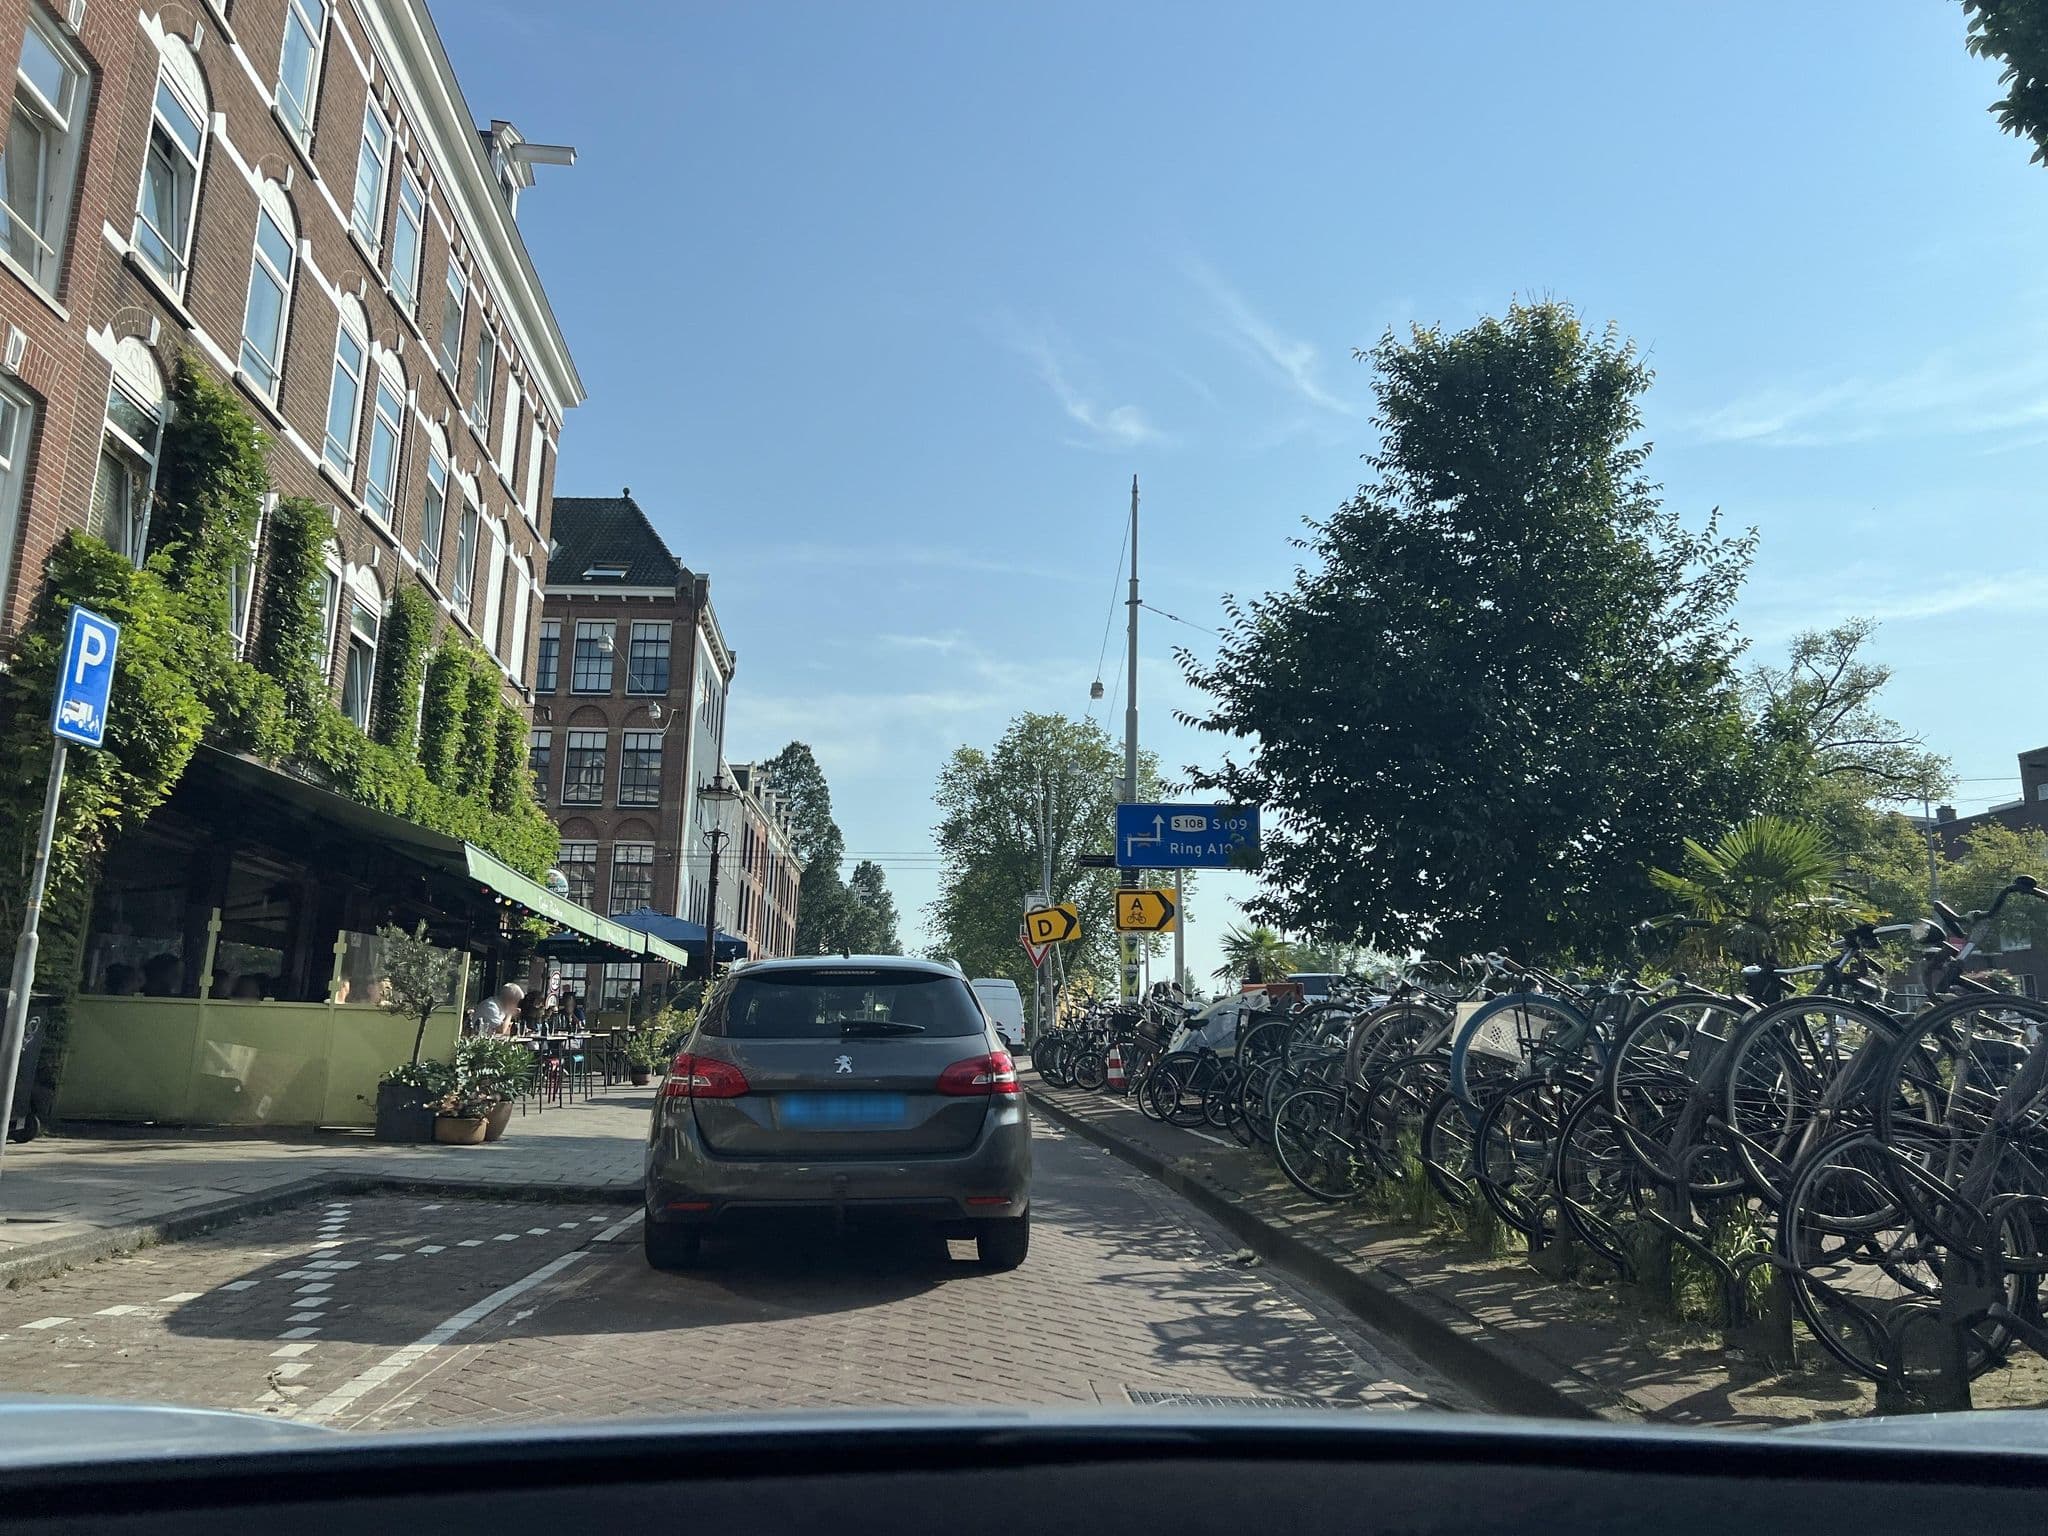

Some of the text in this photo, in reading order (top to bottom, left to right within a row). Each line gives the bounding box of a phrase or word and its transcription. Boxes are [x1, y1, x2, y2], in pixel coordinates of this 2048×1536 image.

[75, 623, 106, 684] P
[1174, 819, 1203, 828] S 108
[1212, 818, 1247, 829] S 109
[1170, 843, 1202, 858] Ring
[1131, 898, 1143, 910] A
[1038, 920, 1052, 936] D
